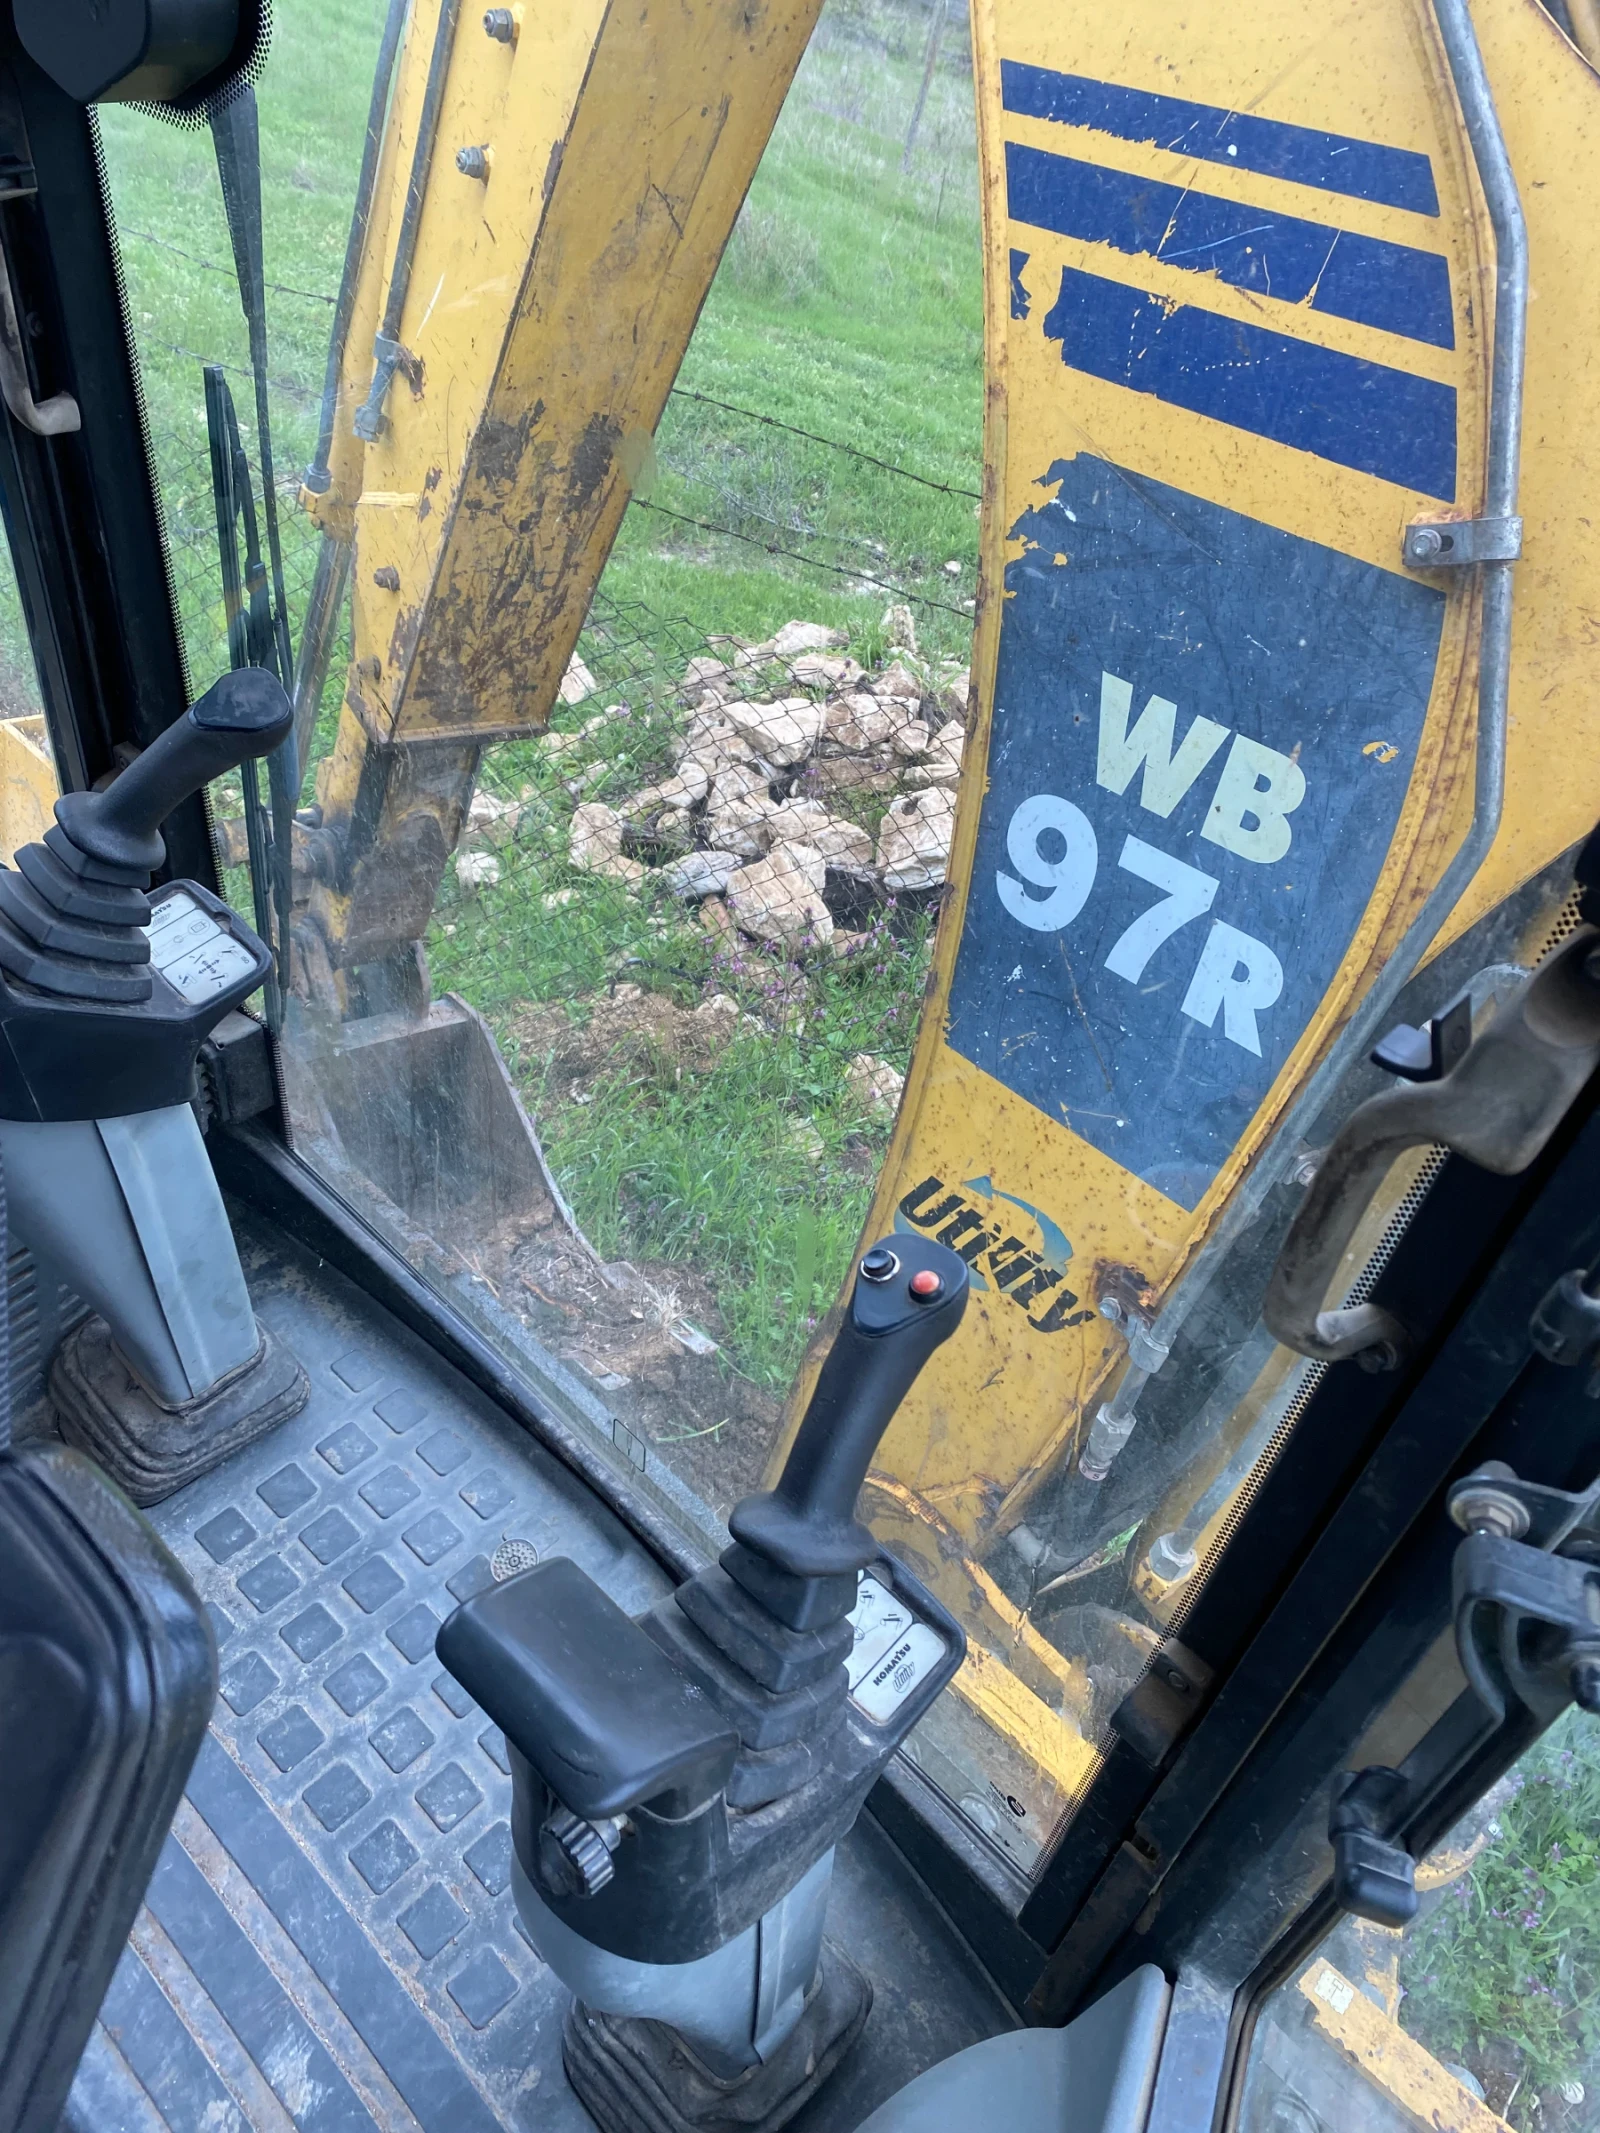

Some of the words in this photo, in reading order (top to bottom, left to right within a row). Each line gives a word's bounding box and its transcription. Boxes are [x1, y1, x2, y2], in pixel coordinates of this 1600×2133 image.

[1097, 671, 1306, 864] WB
[151, 903, 172, 918] ATSU
[996, 794, 1284, 1058] 97R
[899, 1175, 1097, 1333] Utility
[872, 1643, 912, 1686] KOMATSU
